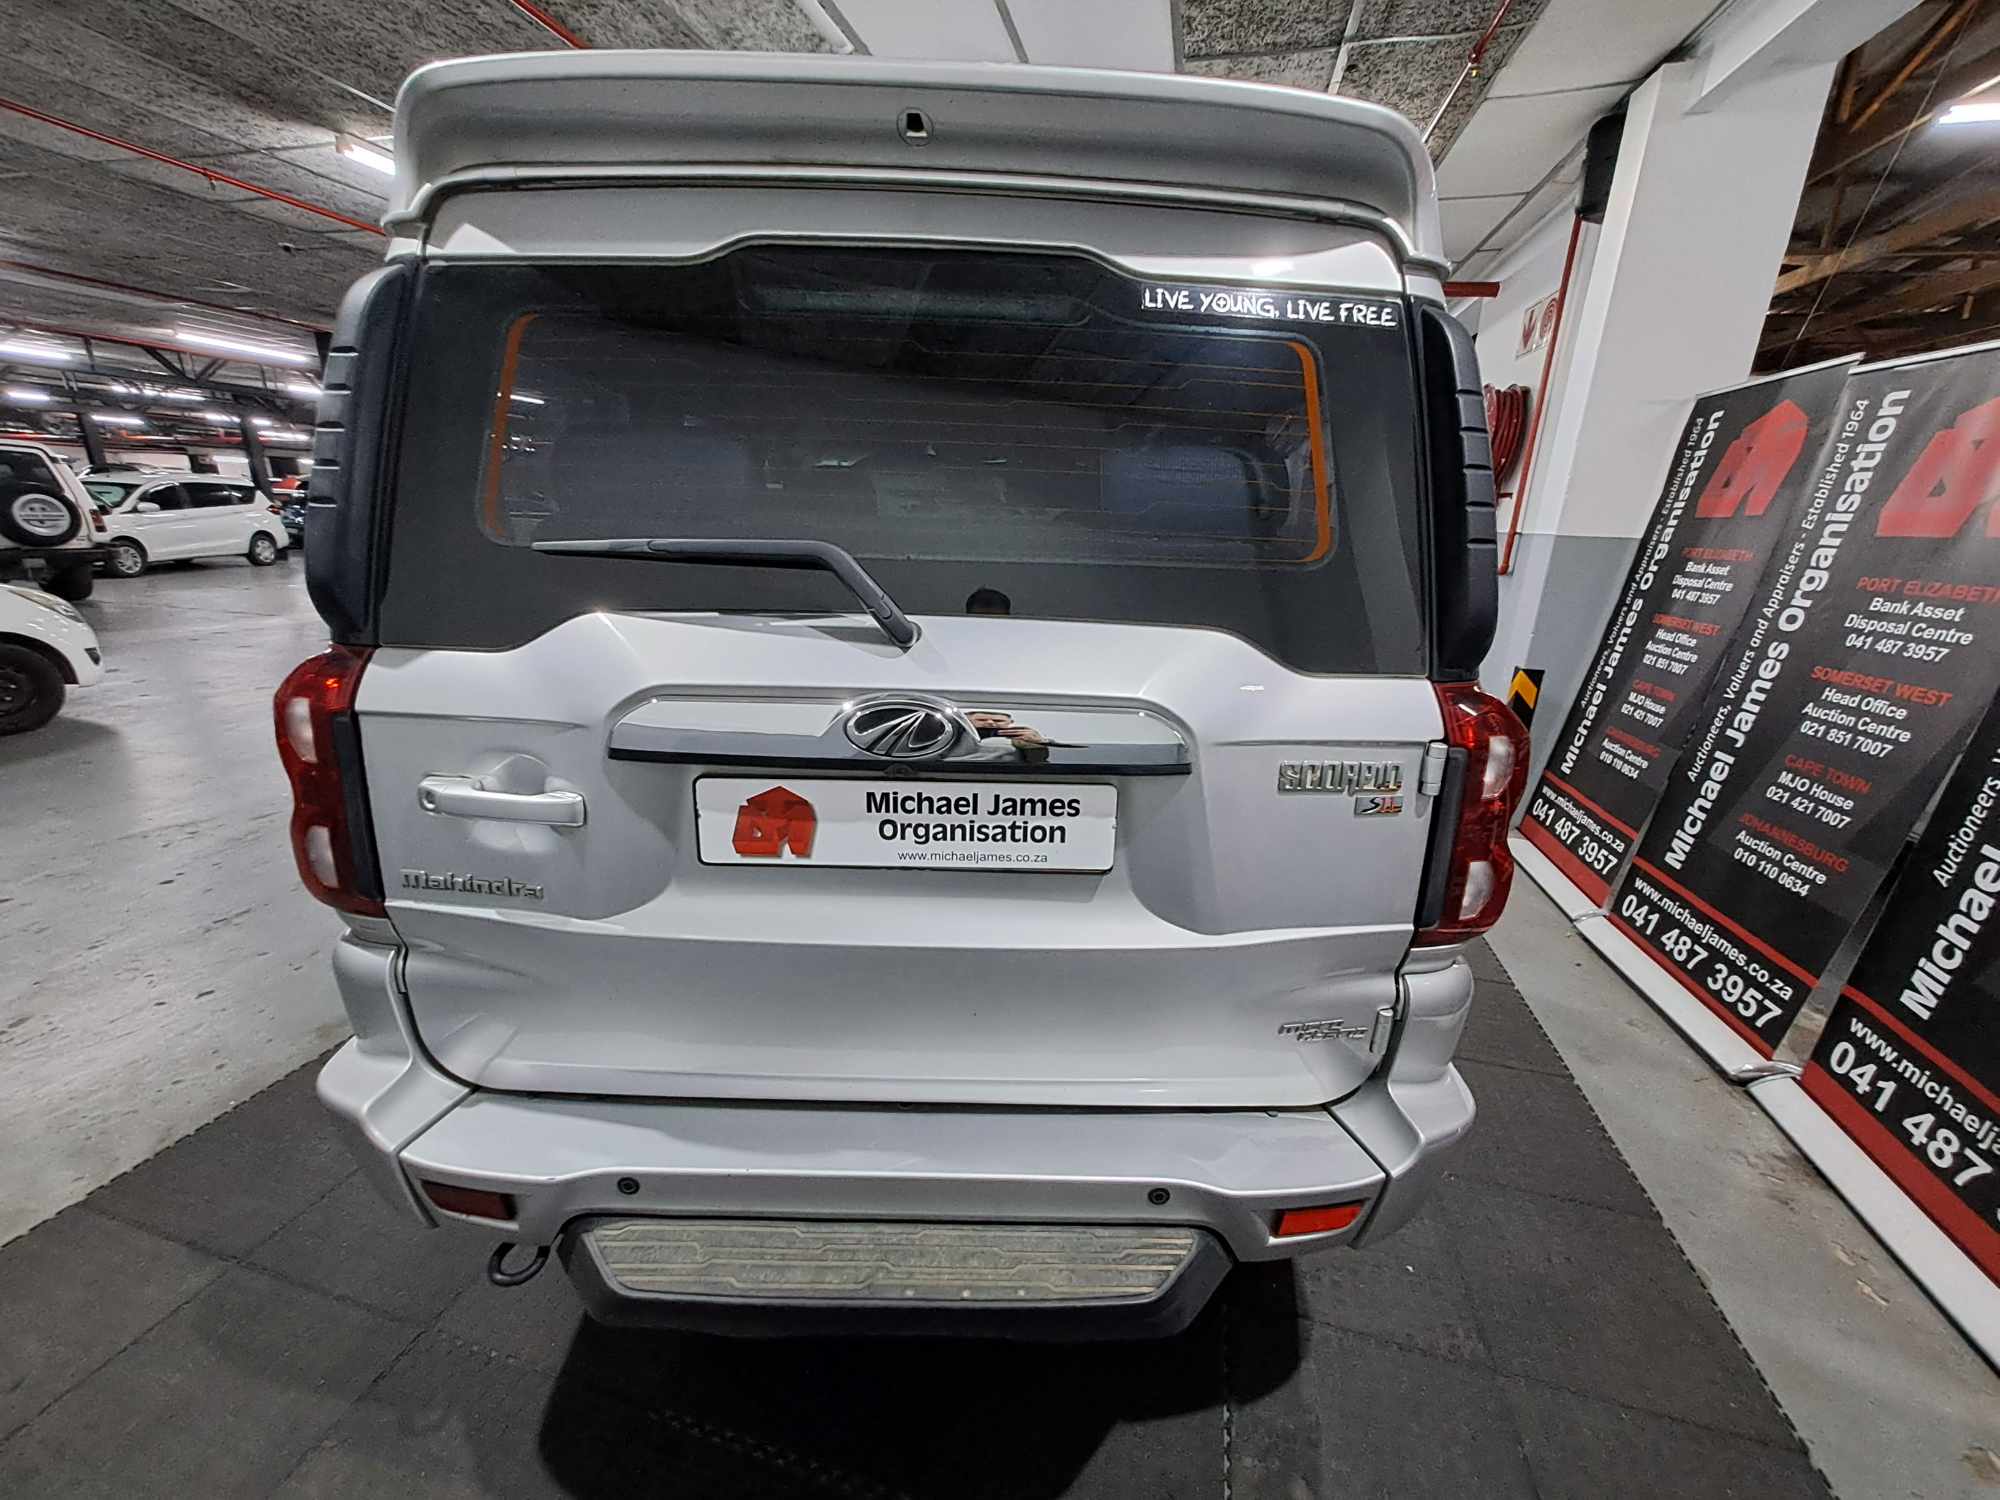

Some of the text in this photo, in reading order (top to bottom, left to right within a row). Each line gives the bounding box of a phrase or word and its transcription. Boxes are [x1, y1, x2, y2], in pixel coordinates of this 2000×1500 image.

[1143, 288, 1194, 310] LIVE
[1287, 300, 1335, 321] LIVE
[1339, 303, 1397, 327] FREE
[1561, 682, 1607, 775] Michael
[1604, 598, 1644, 680] James
[1640, 410, 1725, 590] Organisation
[1687, 703, 1732, 782] Auctioneers,
[1724, 649, 1755, 700] Valuers
[1750, 618, 1769, 648] and
[1762, 541, 1805, 619] Appraisers
[1801, 442, 1850, 530] Established
[1842, 399, 1870, 438] 1964
[1856, 576, 1903, 594] PORT
[1844, 613, 1974, 645] Disposal Centre
[1868, 597, 1966, 622] Bank Asset
[1664, 389, 1912, 871] Michael James Organisation
[1845, 633, 1951, 663] 041 487 3957
[1810, 665, 1953, 707] SOMERSET WEST
[1821, 687, 1908, 720] Head Office
[1800, 720, 1894, 759] 021 851 7007
[1801, 702, 1912, 743] Auction Centre
[1784, 753, 1825, 777] CAPE
[865, 791, 1081, 818] Michael James
[1766, 785, 1852, 829] 021 421 7007
[1777, 770, 1854, 810] MJO House
[878, 818, 1066, 845] Organisation
[1533, 798, 1618, 875] 041 487 3957
[898, 850, 1048, 864] www.michaeljames.co.za
[1733, 847, 1811, 897] 010 110 0634
[1735, 829, 1827, 885] Auction Centre
[1634, 877, 1793, 1001] www.michaeljames.co.za
[1621, 894, 1783, 1029] 041 487 3957
[1830, 1041, 1994, 1187] 041 487
